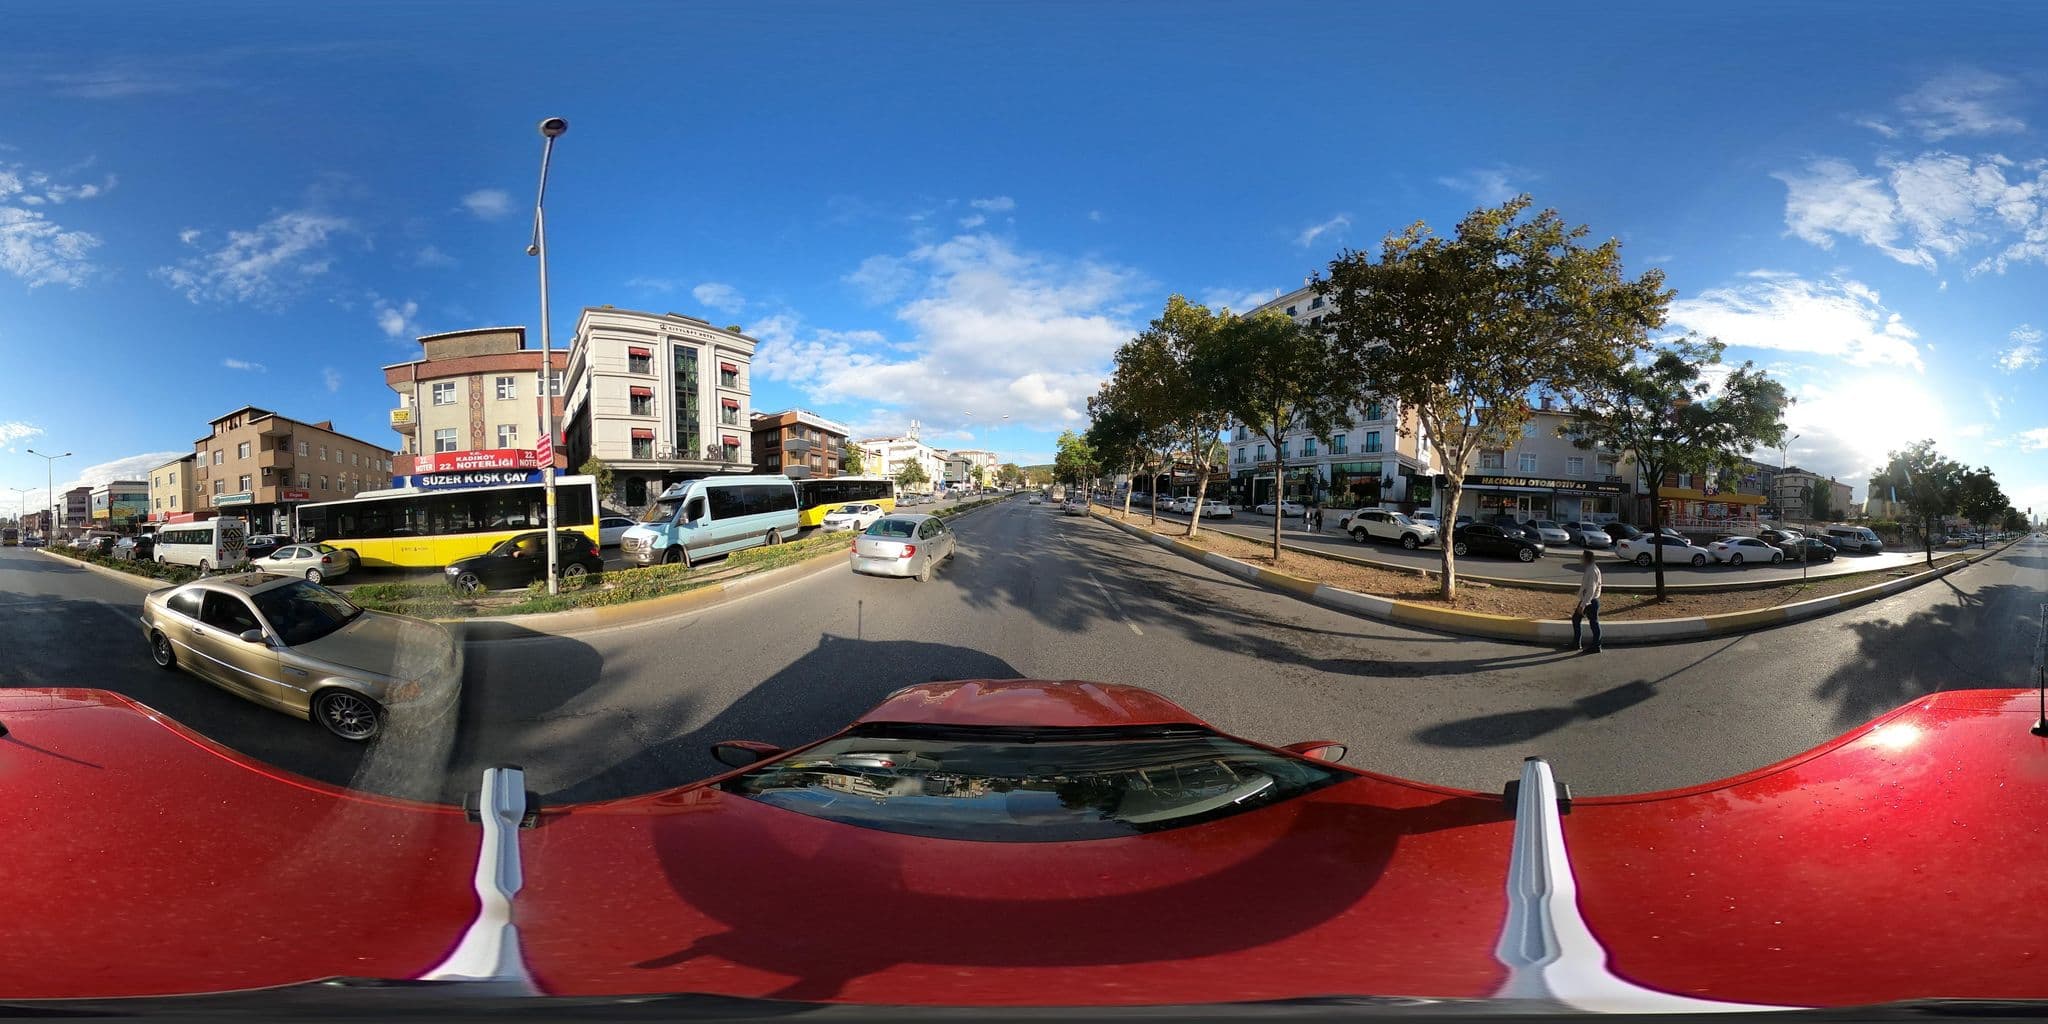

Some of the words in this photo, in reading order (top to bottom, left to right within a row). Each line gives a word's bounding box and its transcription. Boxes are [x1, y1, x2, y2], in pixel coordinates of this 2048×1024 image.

[520, 459, 538, 467] NOTE
[422, 474, 461, 486] SÜZER
[503, 472, 528, 484] ÇAY
